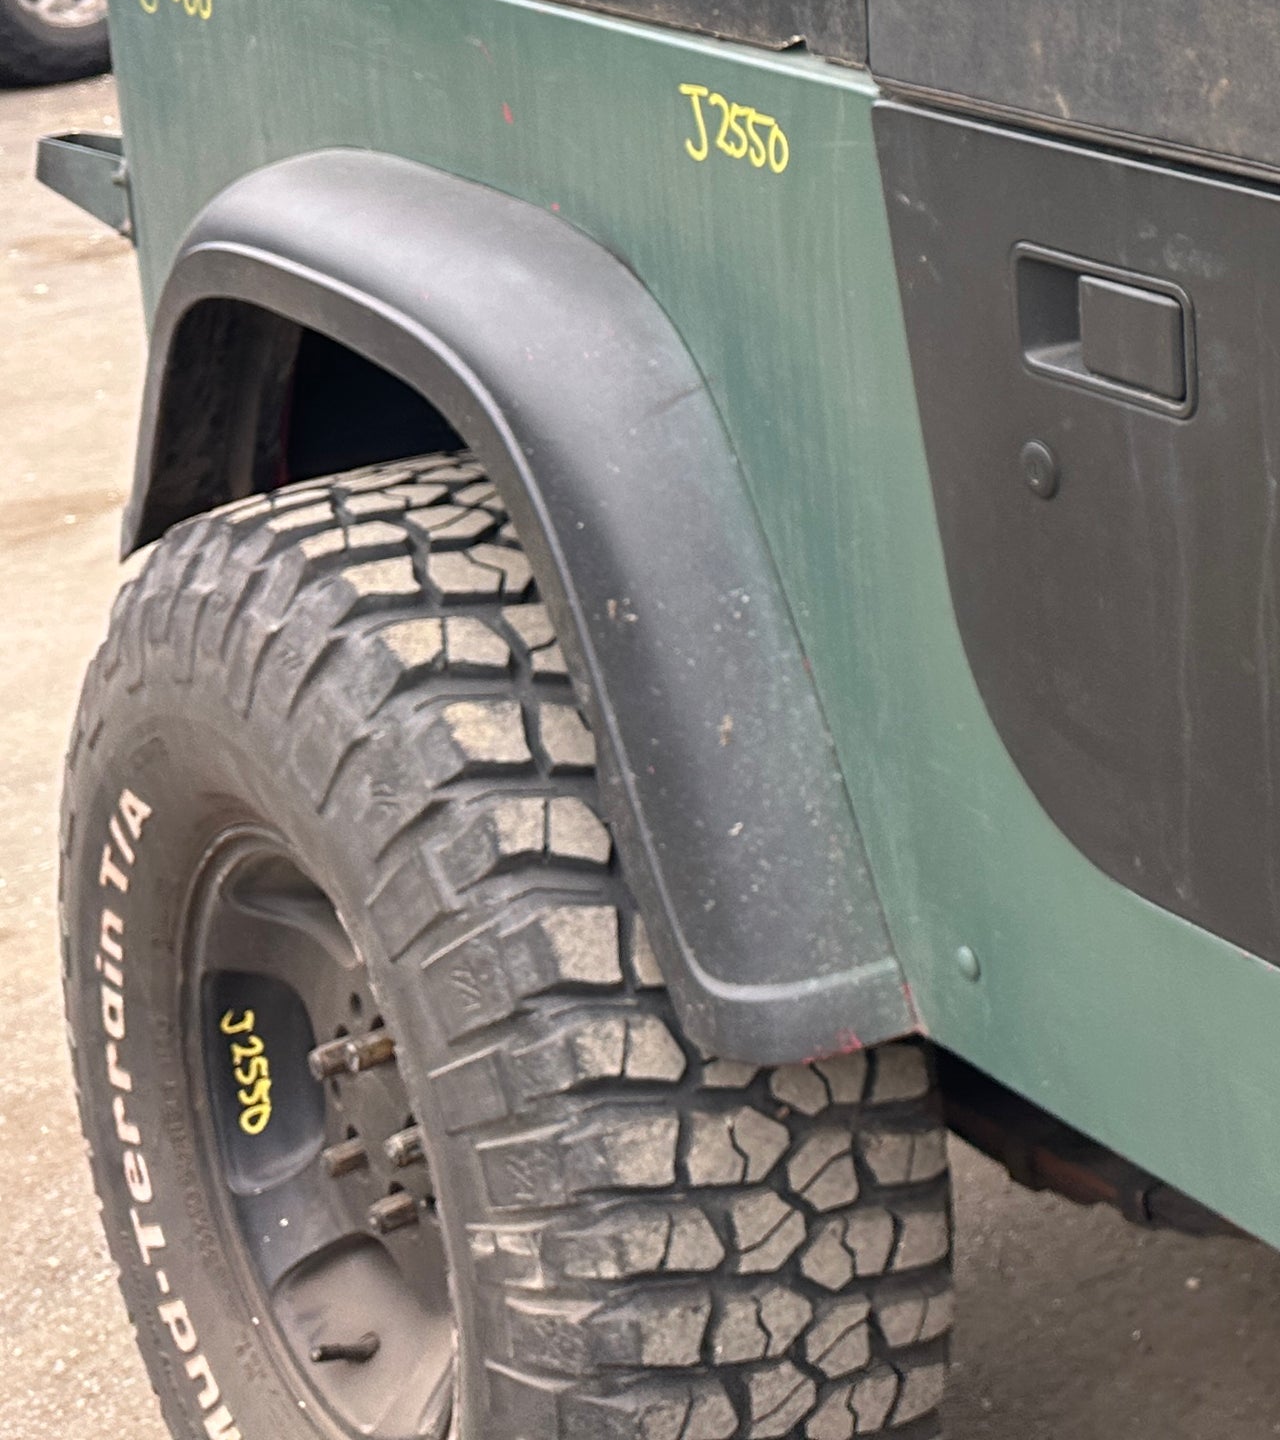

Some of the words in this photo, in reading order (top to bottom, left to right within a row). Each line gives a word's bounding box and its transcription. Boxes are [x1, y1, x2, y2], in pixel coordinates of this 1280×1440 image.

[678, 83, 791, 175] J2550
[99, 788, 153, 893] T/A
[219, 1009, 273, 1135] J2550
